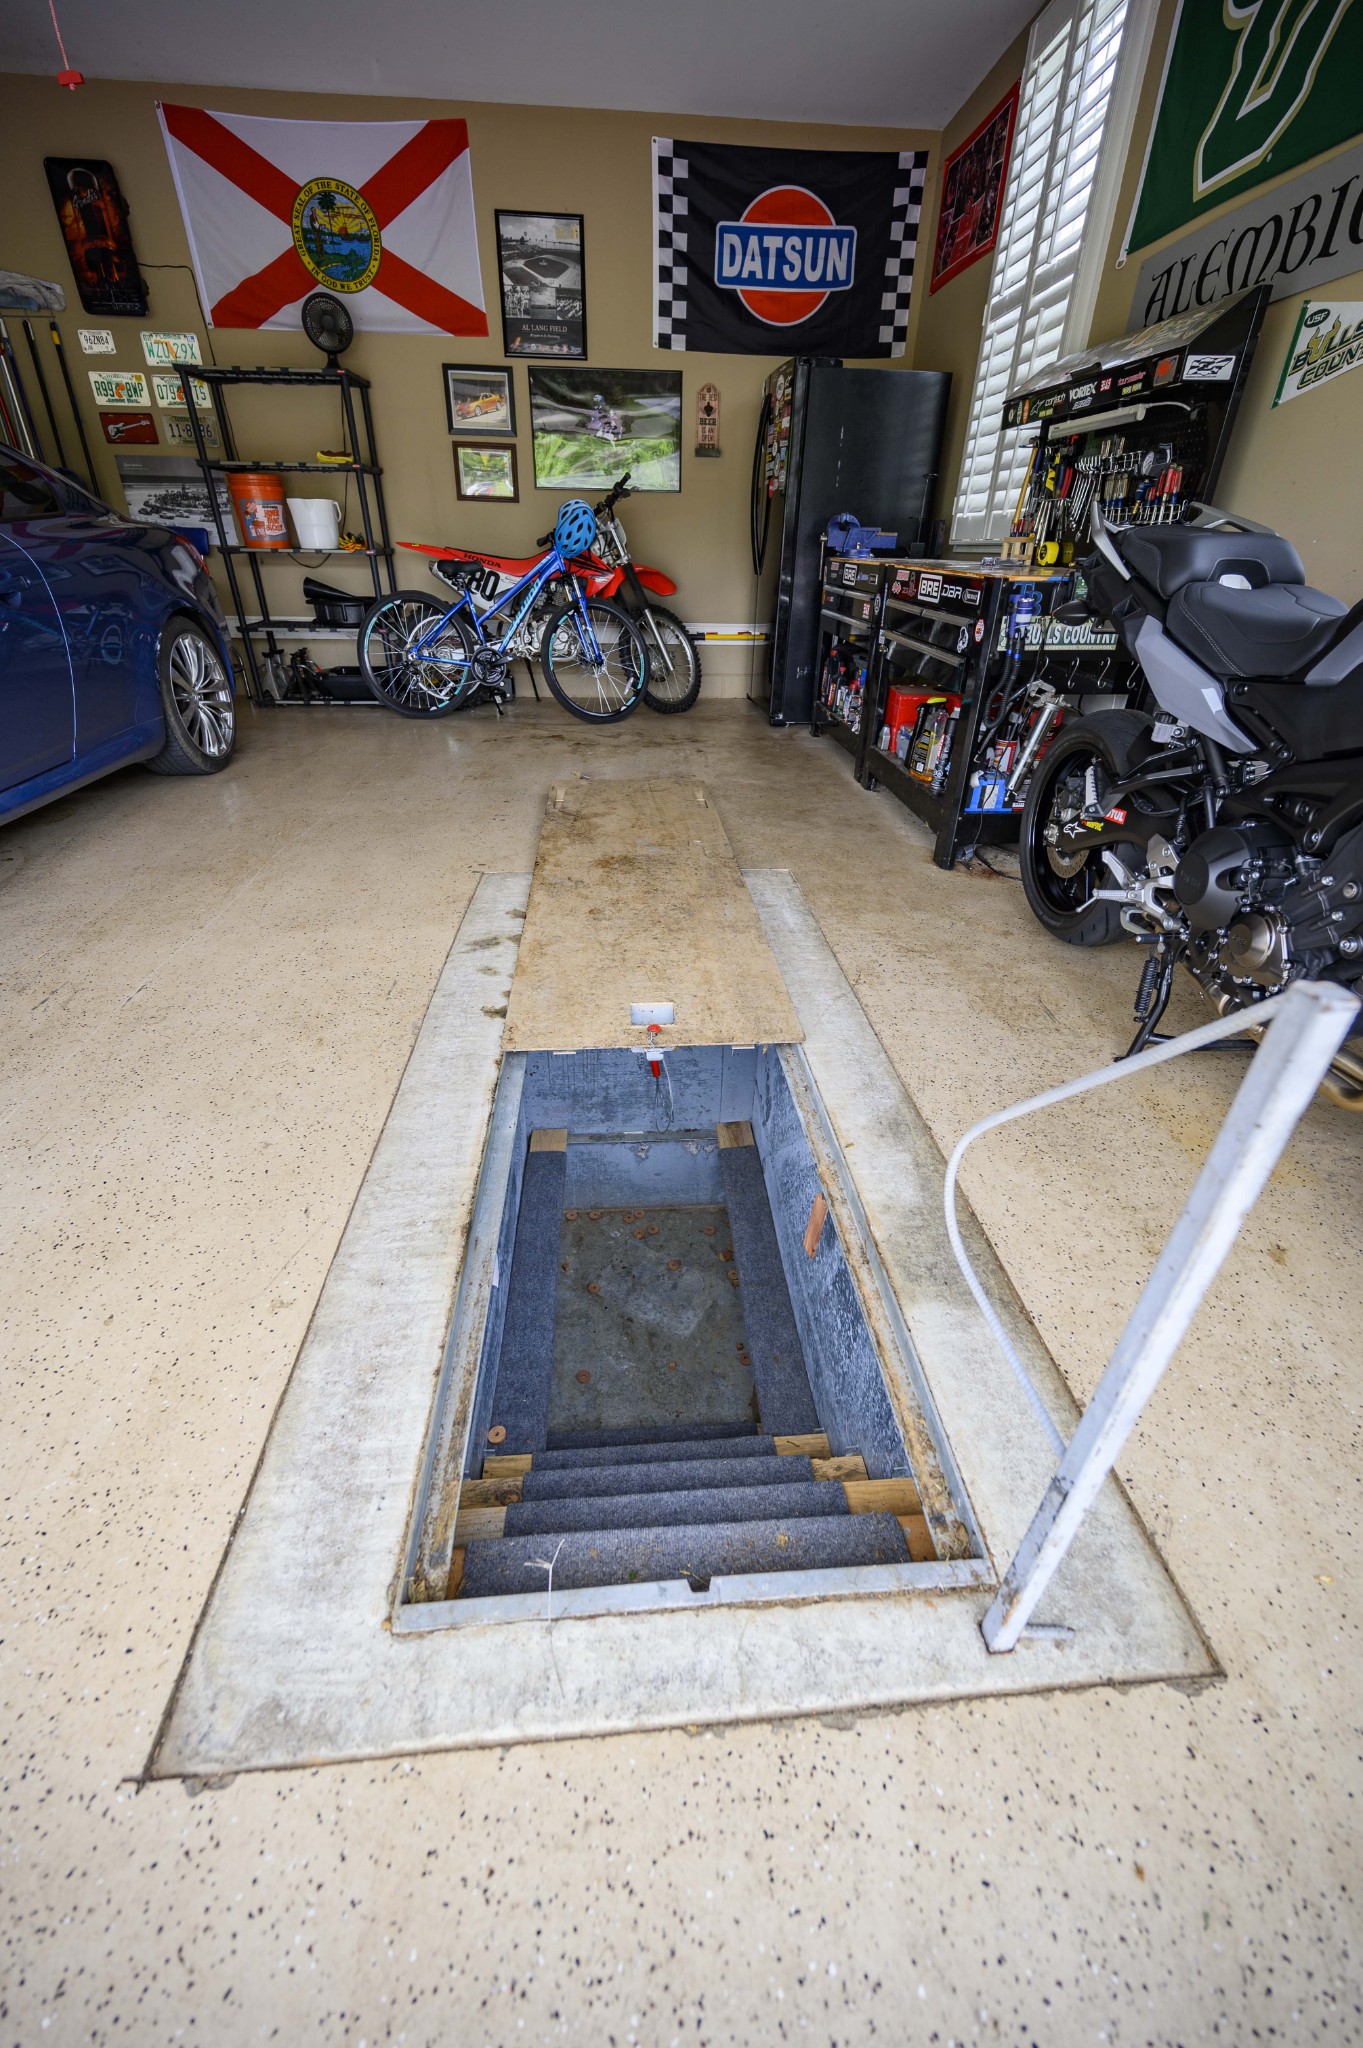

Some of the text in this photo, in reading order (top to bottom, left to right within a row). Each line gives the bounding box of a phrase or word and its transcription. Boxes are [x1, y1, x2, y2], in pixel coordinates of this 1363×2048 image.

[293, 181, 380, 262] GREAT SEAL OF THE STATE OF FLORIDA
[722, 233, 850, 282] DATSUN
[311, 266, 375, 291] IN GOD WE TRUST
[1306, 311, 1328, 325] USF
[531, 324, 549, 332] LANG
[549, 325, 568, 333] FIELD
[172, 342, 197, 360] 29X
[1297, 342, 1363, 390] COUN
[94, 380, 115, 397] R99
[1069, 381, 1098, 402] VORTEX
[699, 417, 717, 426] BEER
[463, 553, 502, 568] HONDA
[920, 579, 940, 597] BRE
[1106, 809, 1124, 822] TUL
